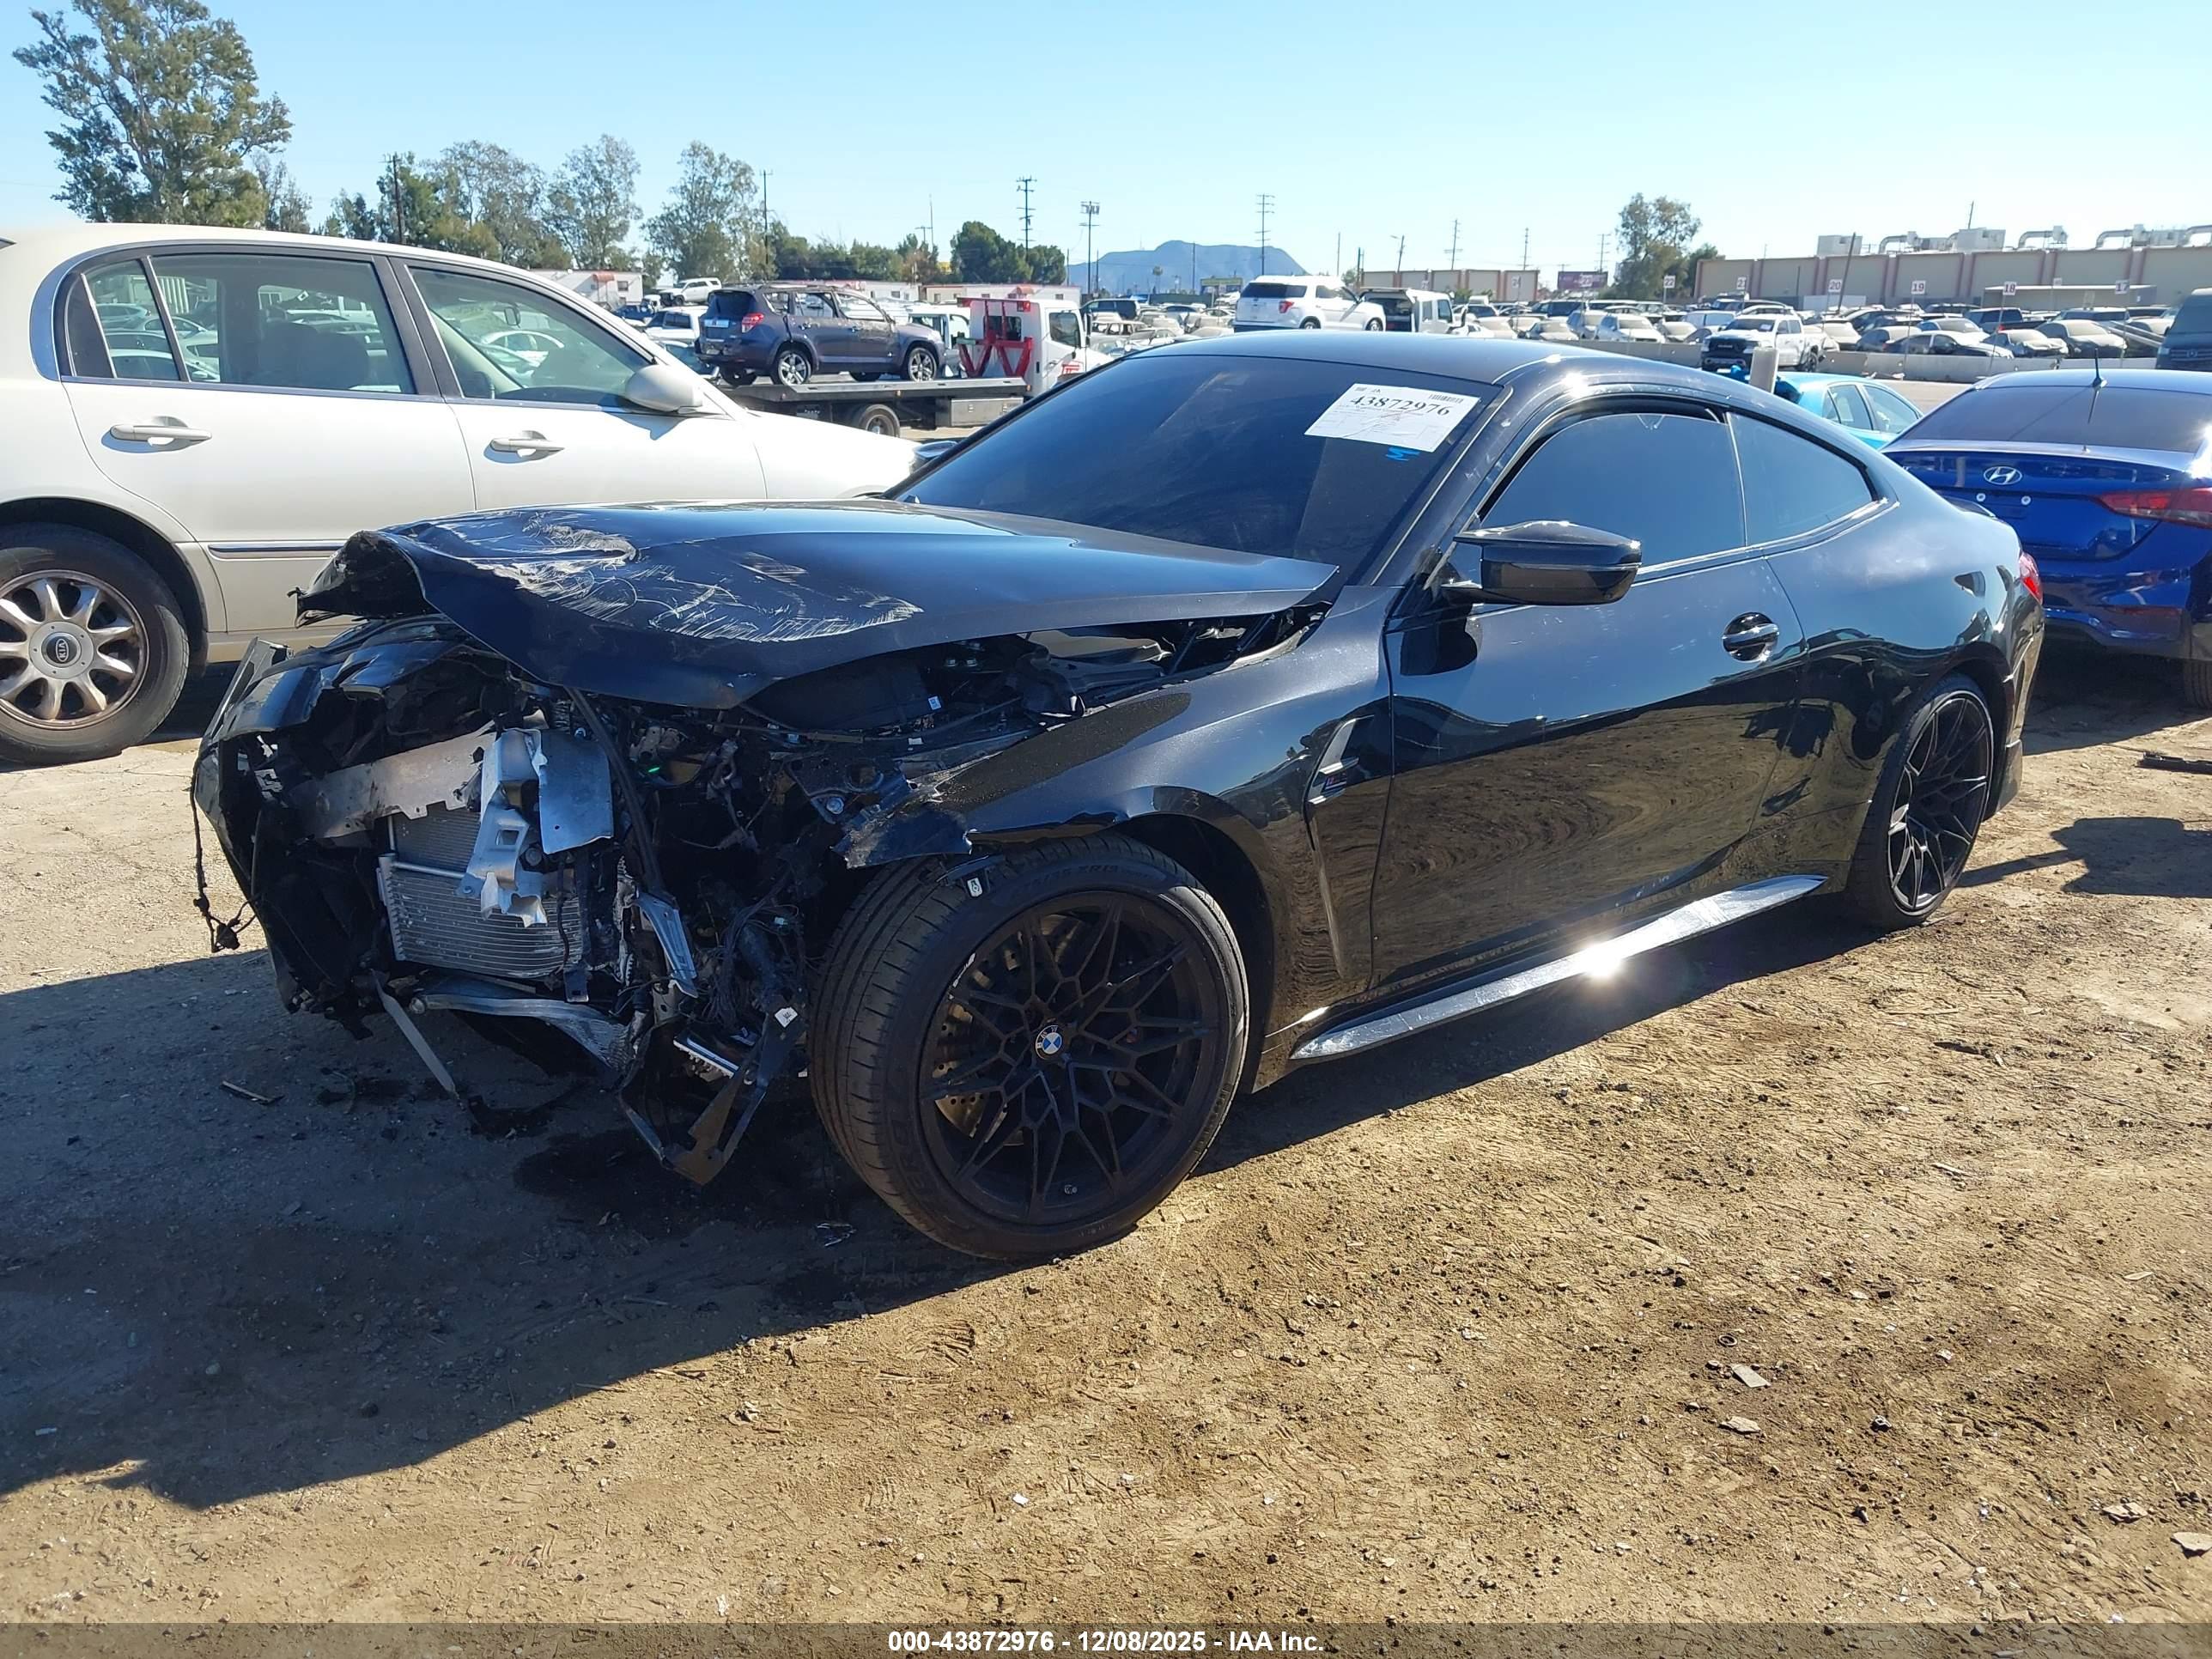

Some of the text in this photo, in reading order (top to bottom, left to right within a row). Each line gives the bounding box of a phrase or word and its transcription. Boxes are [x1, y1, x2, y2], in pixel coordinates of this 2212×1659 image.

[1829, 282, 1841, 290] 20
[1913, 283, 1924, 292] 19
[2004, 284, 2016, 293] 18
[1350, 395, 1453, 416] 43872976
[58, 641, 67, 659] KIA
